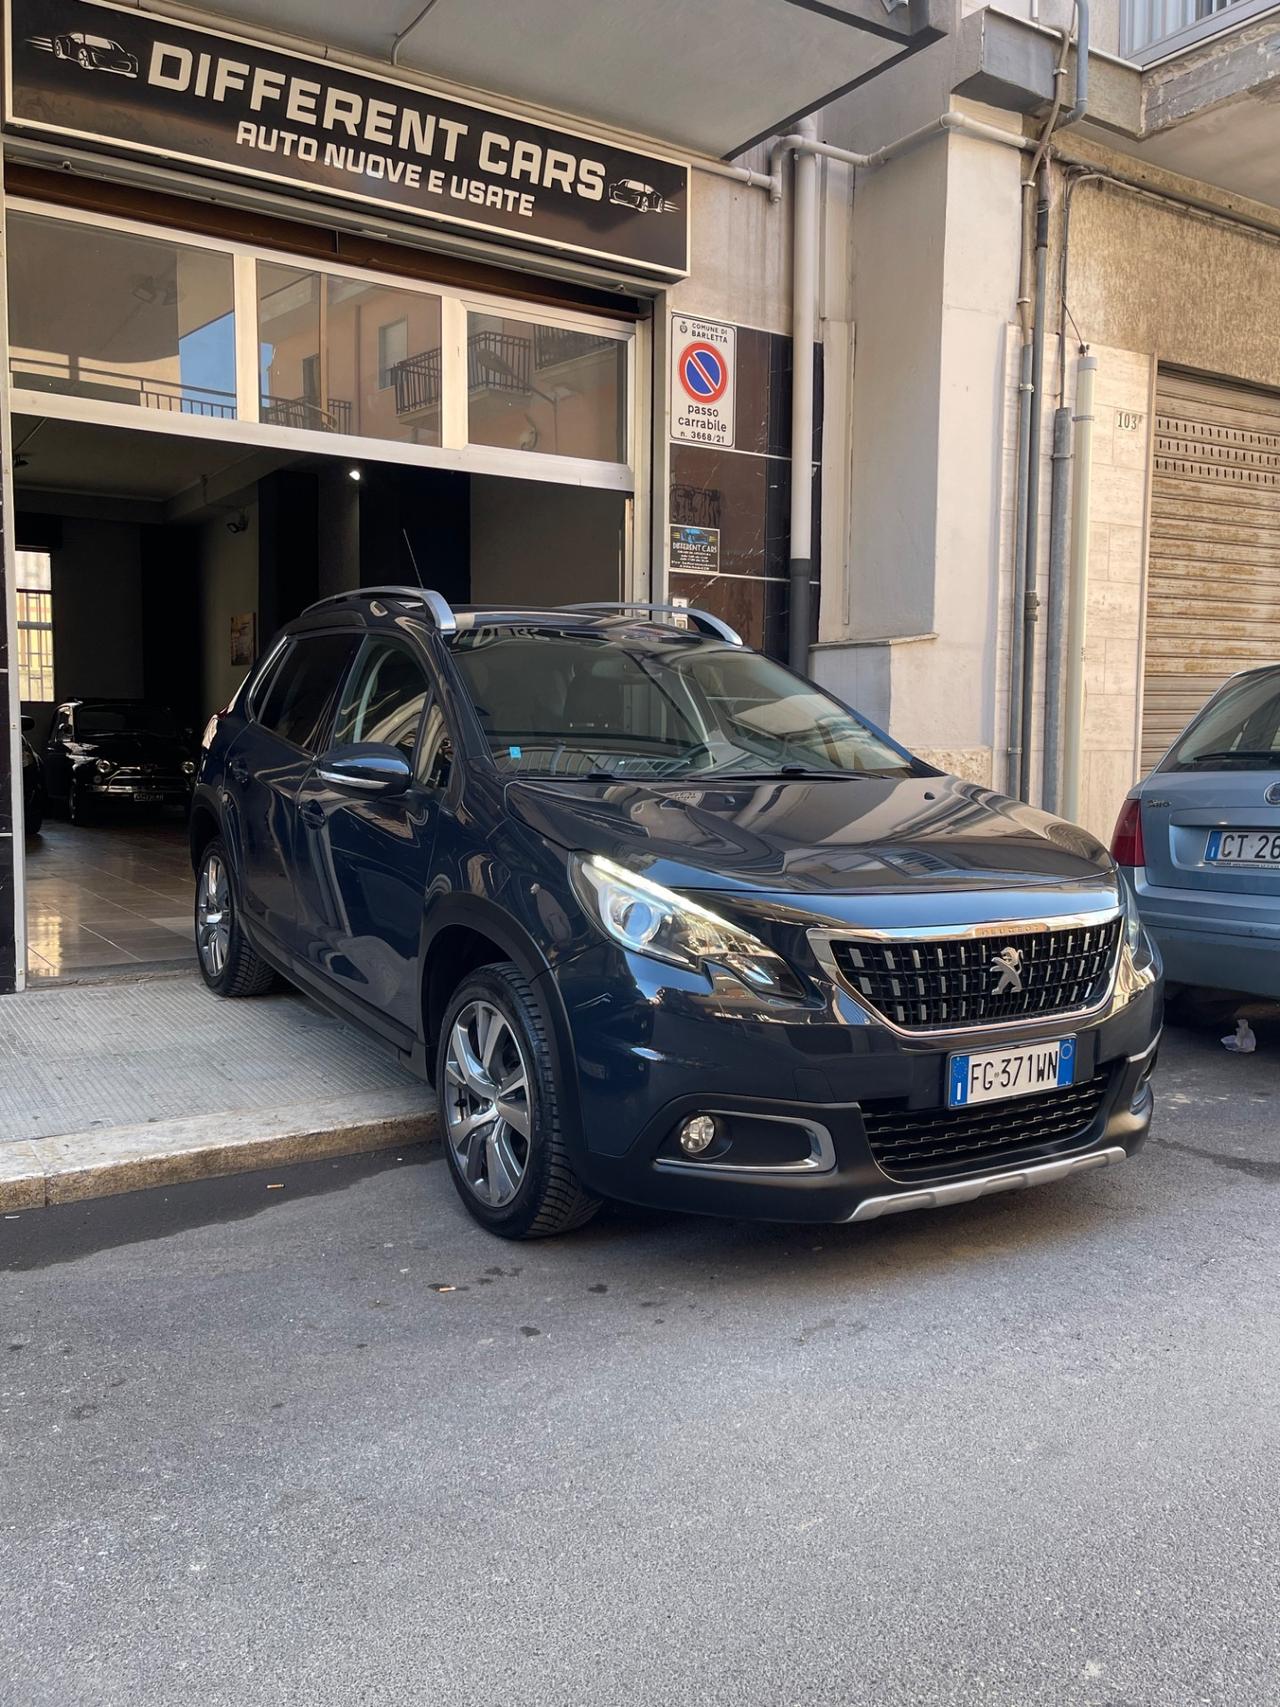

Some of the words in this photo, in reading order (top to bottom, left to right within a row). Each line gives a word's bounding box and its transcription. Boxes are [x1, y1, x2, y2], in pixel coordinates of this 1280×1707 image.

[148, 41, 469, 162] DIFFERENT
[478, 131, 606, 201] CARS
[236, 120, 318, 162] AUTO
[324, 143, 422, 189] NUOVE
[428, 169, 446, 194] E
[450, 175, 535, 217] USATE
[692, 322, 719, 333] COMUNE
[721, 328, 728, 336] DI
[691, 330, 728, 344] BARLETTA
[687, 404, 719, 418] passo
[678, 417, 727, 432] carrabile
[691, 431, 725, 444] 3668/21
[1221, 834, 1249, 858] CT
